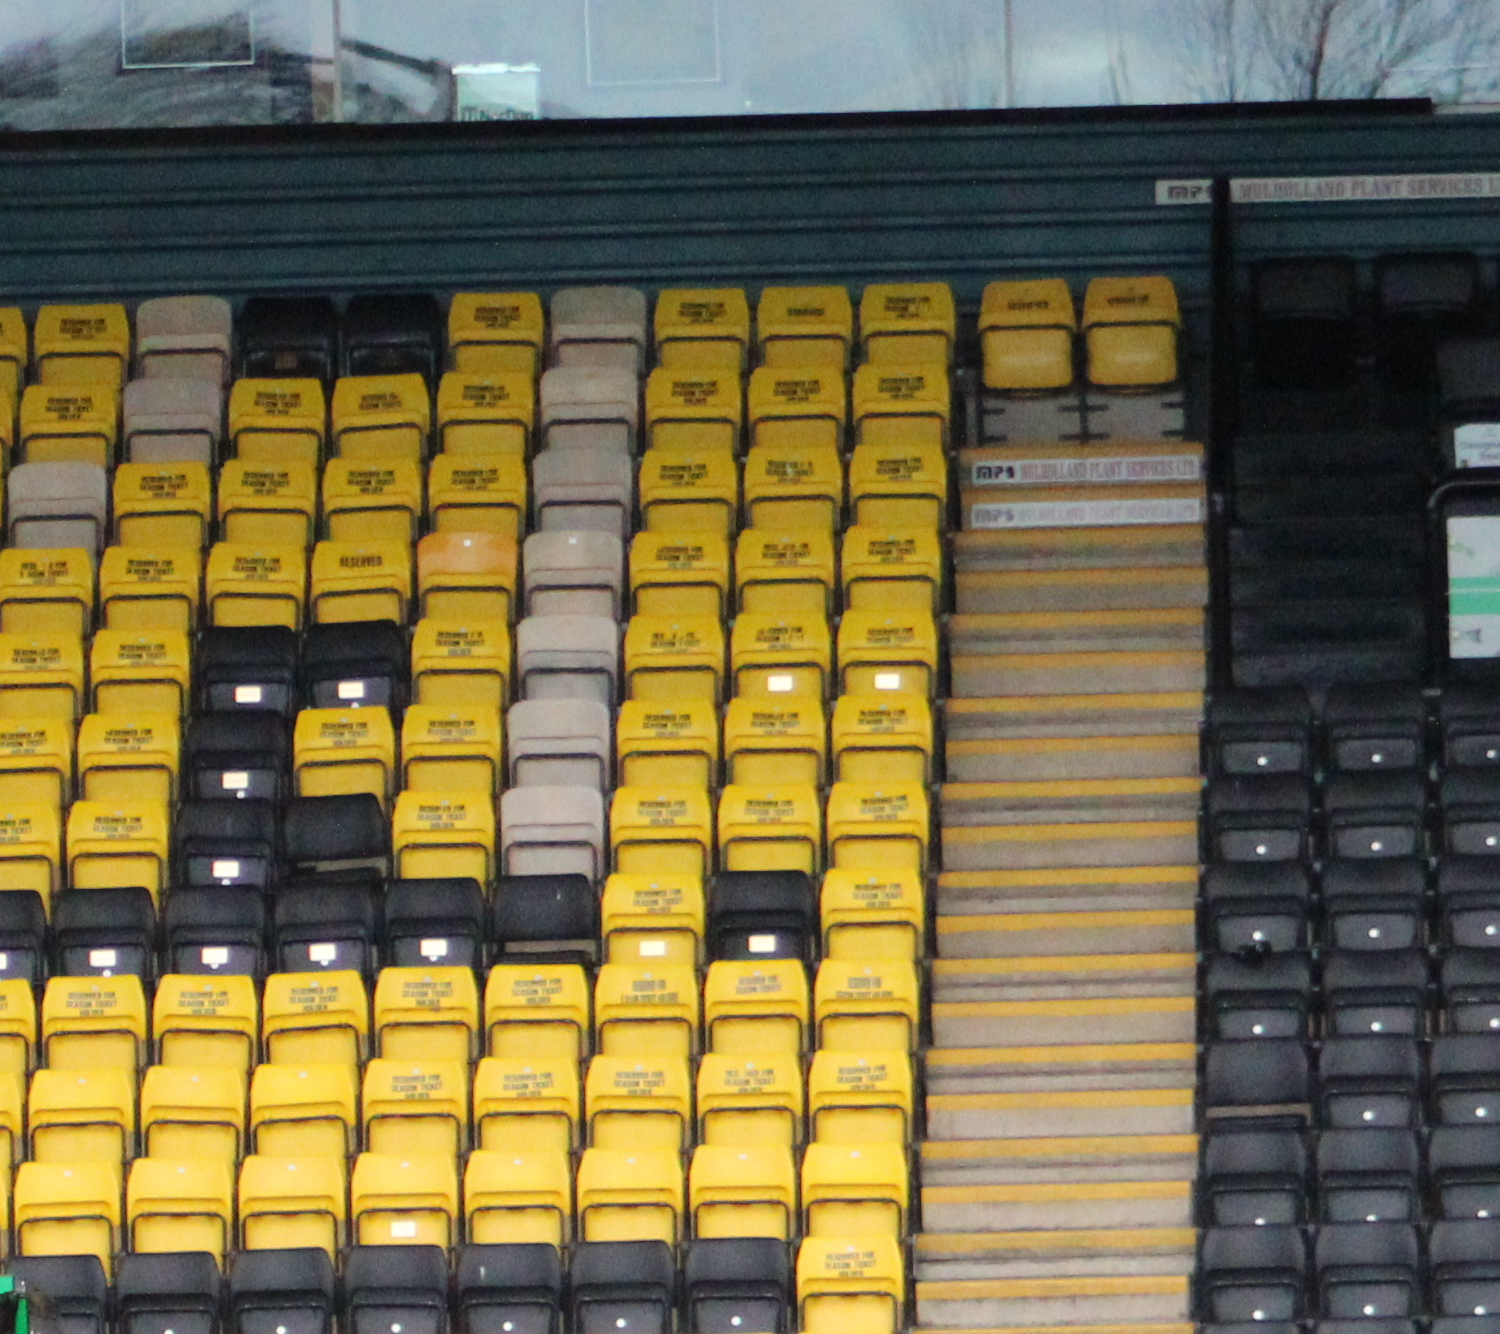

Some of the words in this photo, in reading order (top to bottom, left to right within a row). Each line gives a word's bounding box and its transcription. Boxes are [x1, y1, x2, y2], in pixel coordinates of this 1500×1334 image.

[1350, 179, 1401, 197] PLANT
[1407, 178, 1483, 196] SERVICES
[340, 556, 382, 567] RESERVED
